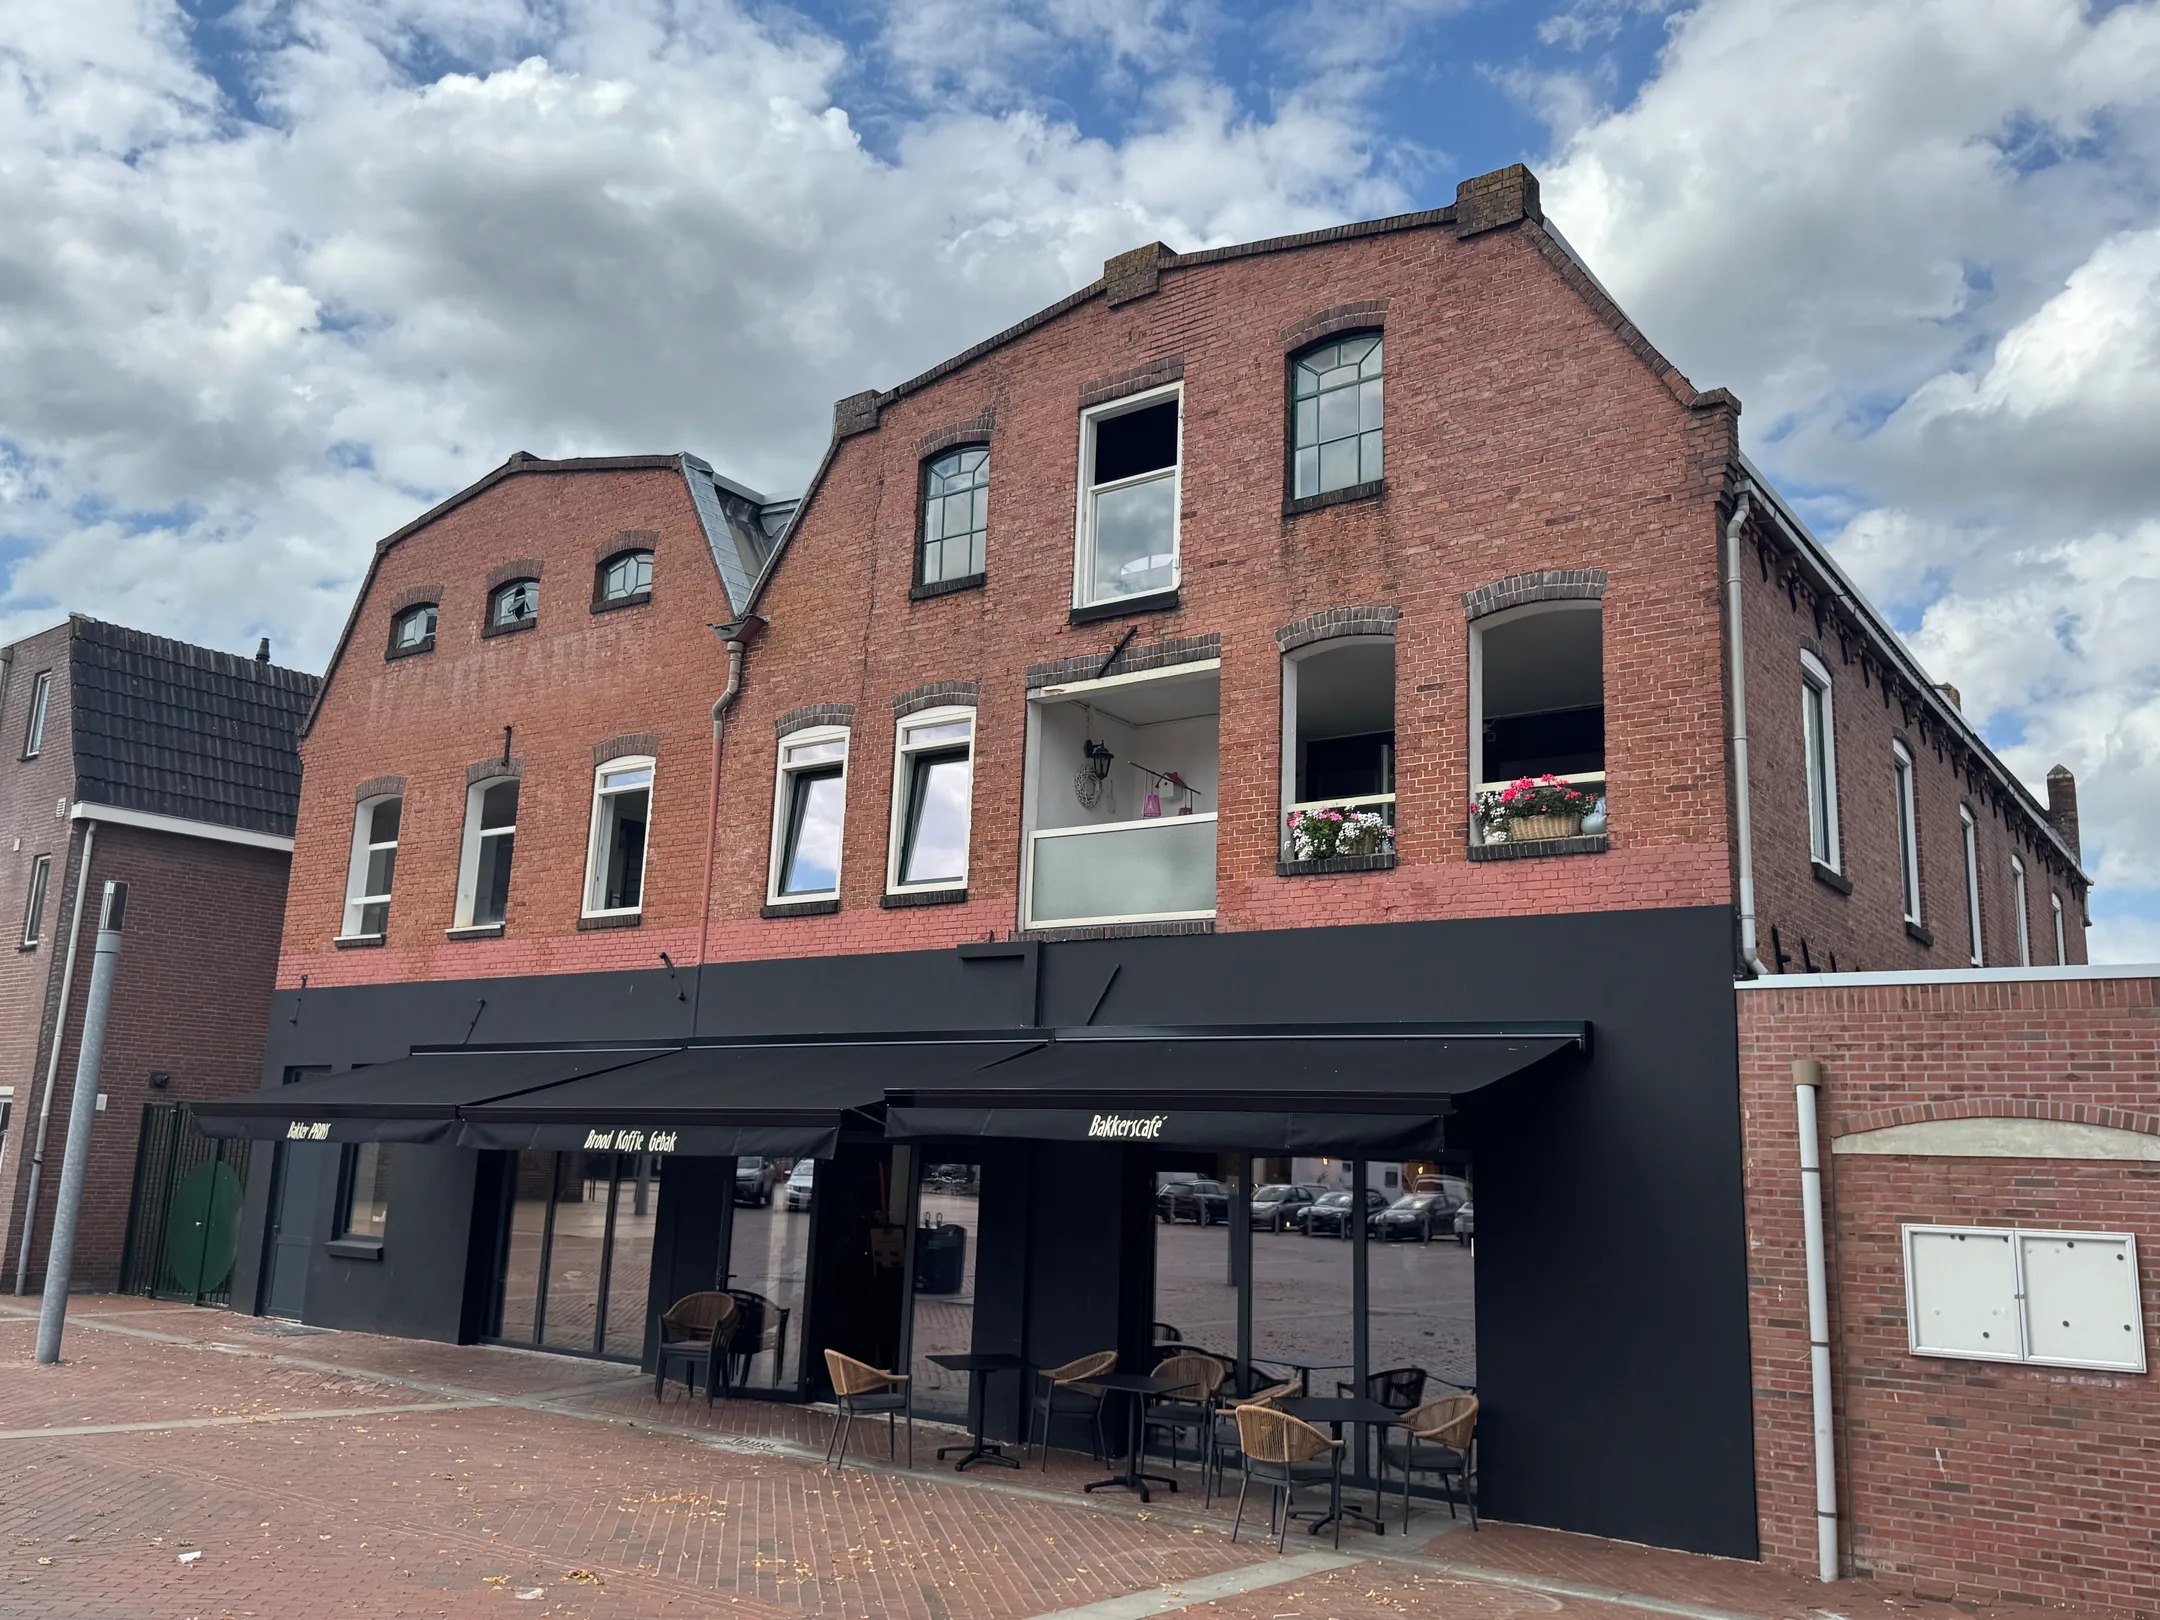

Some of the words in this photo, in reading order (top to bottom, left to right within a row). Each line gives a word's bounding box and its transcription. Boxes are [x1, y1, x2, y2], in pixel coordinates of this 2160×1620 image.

[286, 1121, 310, 1140] Bakker
[1088, 1114, 1169, 1140] Bakkerscafé
[583, 1129, 615, 1150] Brood
[614, 1129, 645, 1153] Koffie
[648, 1130, 678, 1153] Gebak
